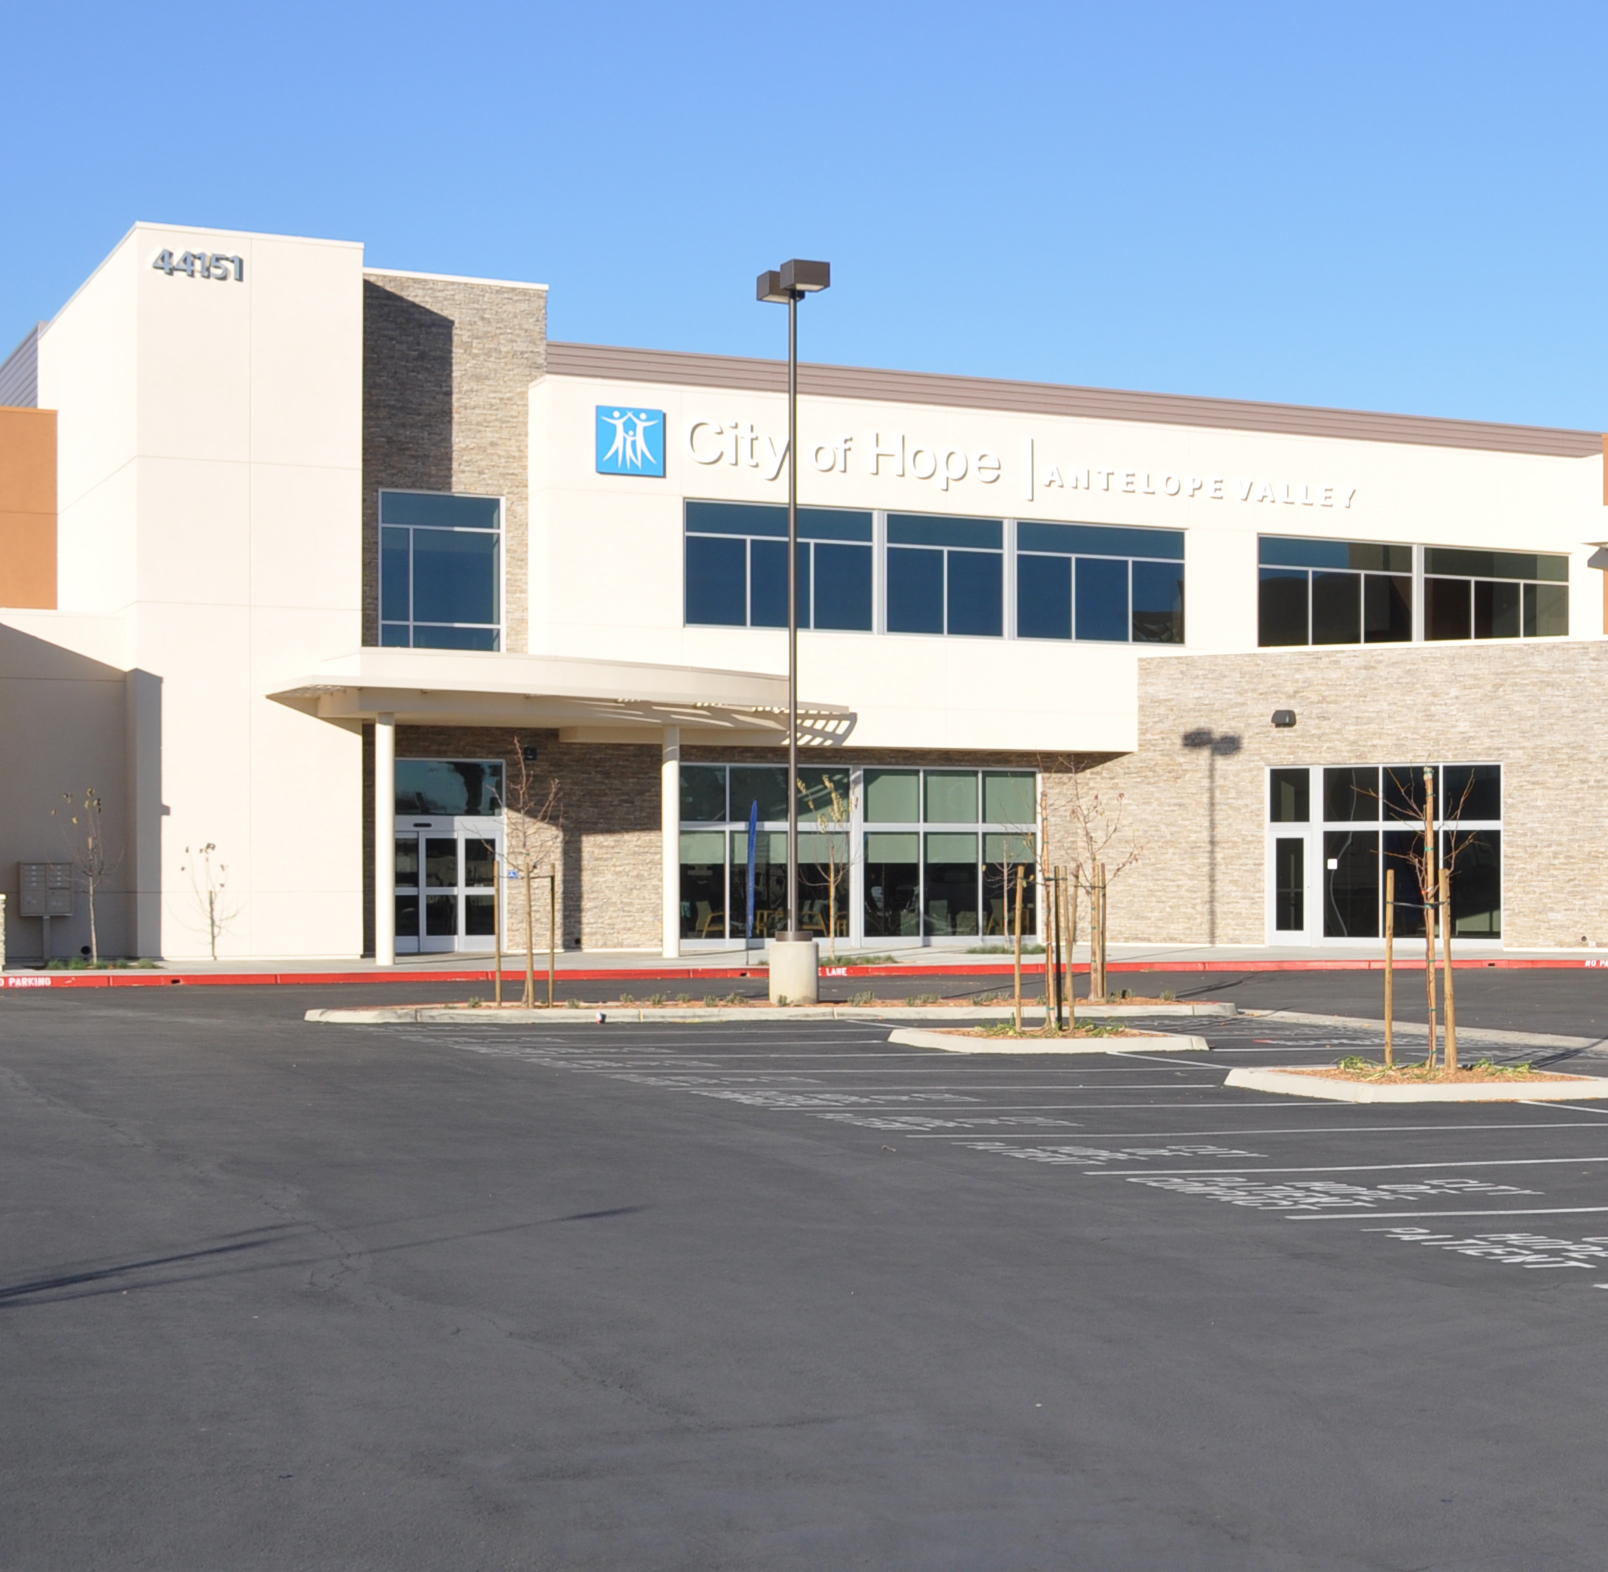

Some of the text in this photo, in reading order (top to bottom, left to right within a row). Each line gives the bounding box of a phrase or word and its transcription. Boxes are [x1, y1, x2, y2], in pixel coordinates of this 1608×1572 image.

[152, 248, 244, 282] 44151
[685, 415, 1001, 492] City of Hope
[1043, 465, 1357, 509] ANTELOPE VALLEY
[8, 976, 52, 987] PARKING
[825, 967, 848, 977] LANE
[1423, 1178, 1546, 1196] CITY
[1360, 1226, 1598, 1269] PATIENT
